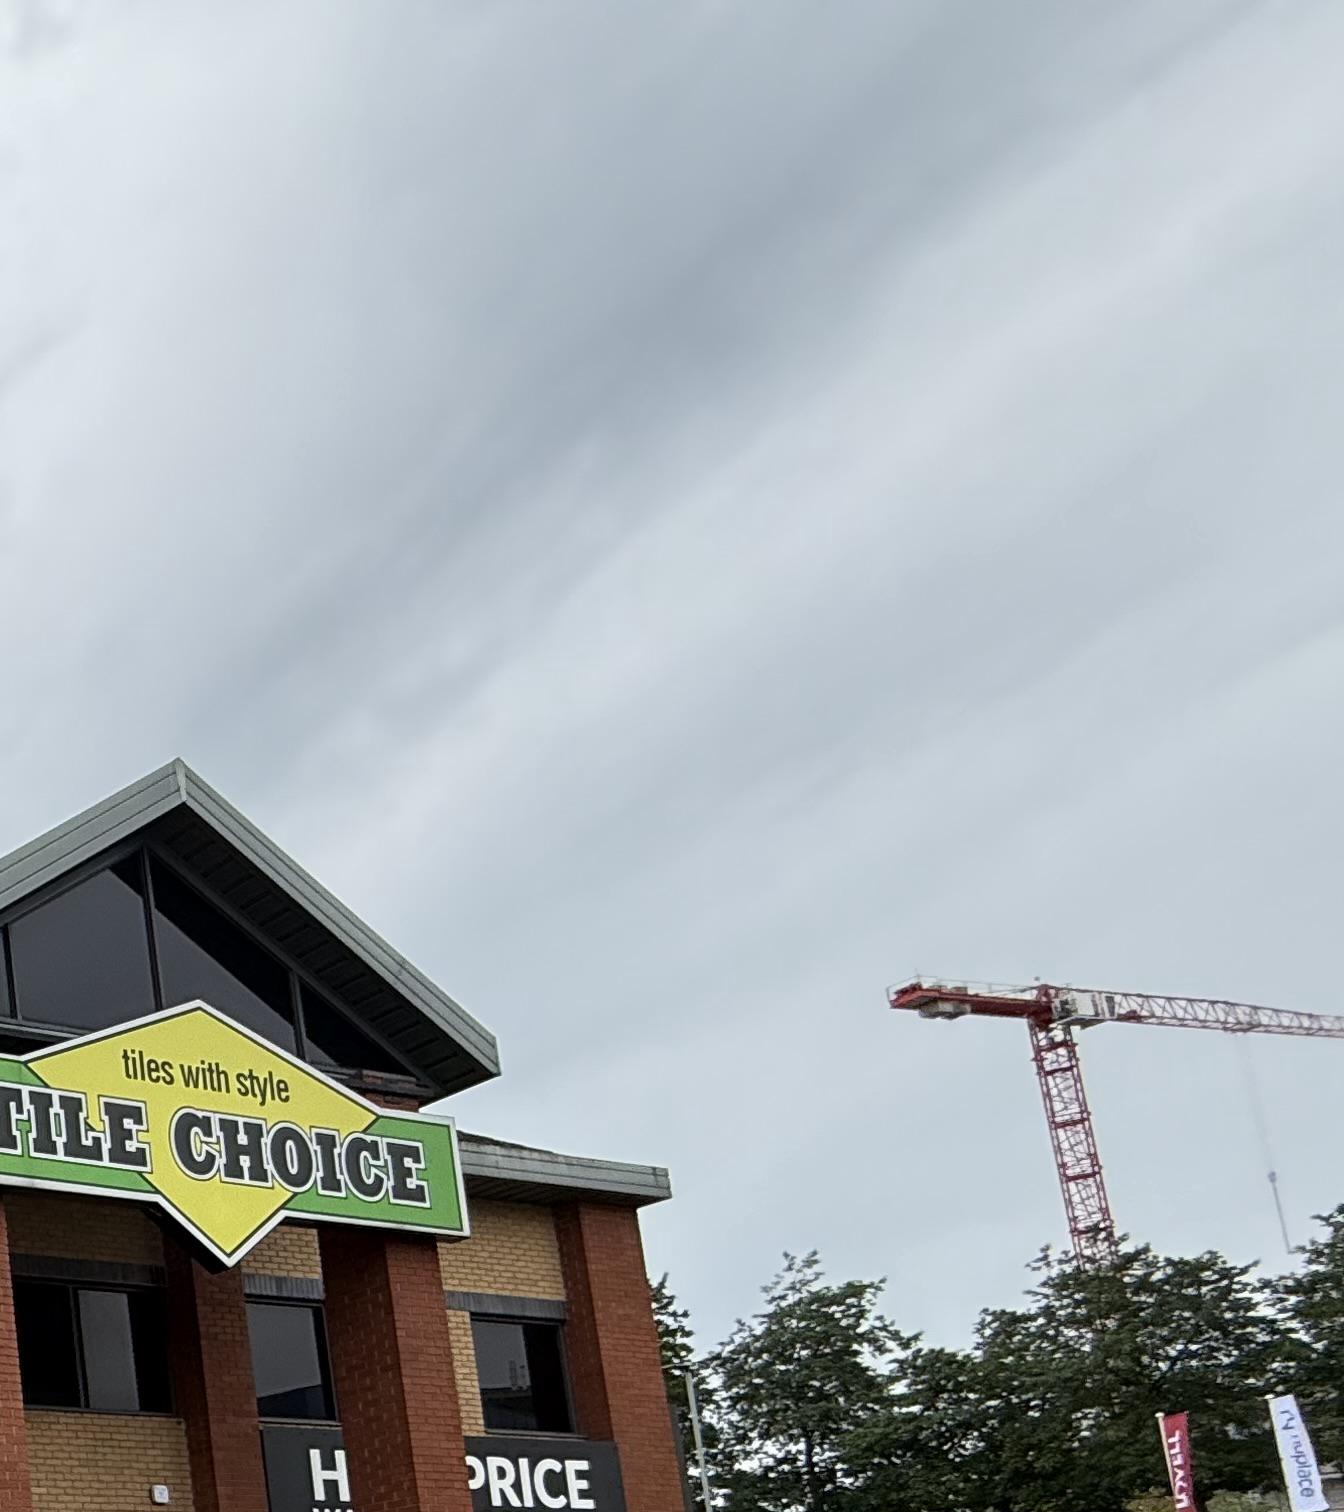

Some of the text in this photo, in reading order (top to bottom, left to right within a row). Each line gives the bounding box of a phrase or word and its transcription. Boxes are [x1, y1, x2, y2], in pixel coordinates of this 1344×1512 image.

[122, 1049, 290, 1107] tiles with style
[172, 1109, 429, 1206] CHOICE
